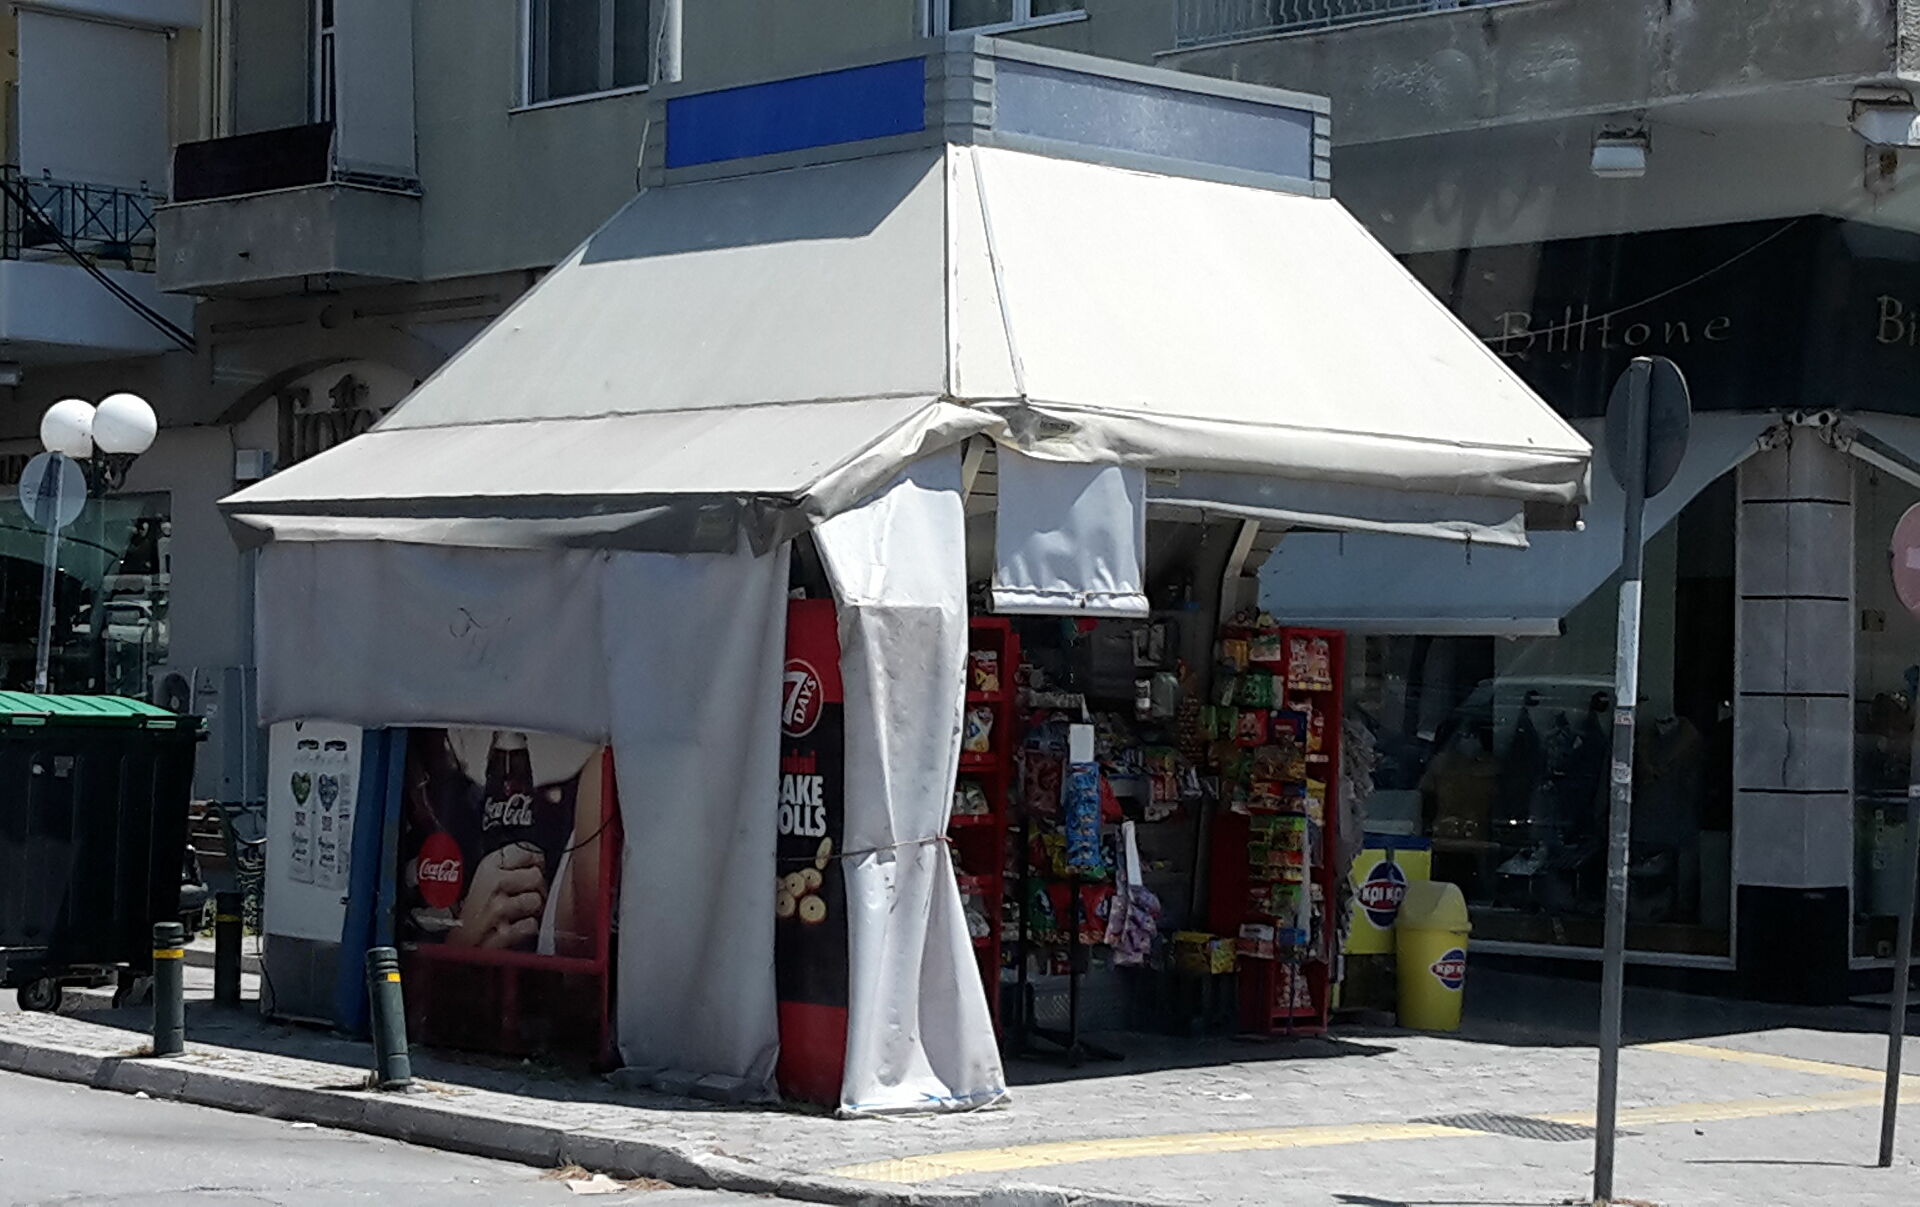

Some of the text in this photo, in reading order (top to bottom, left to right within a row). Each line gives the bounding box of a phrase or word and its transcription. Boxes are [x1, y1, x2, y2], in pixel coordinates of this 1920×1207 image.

[1494, 303, 1732, 358] Billtone
[793, 677, 818, 725] DAYS
[780, 774, 824, 806] AKE
[778, 804, 827, 838] OLLS
